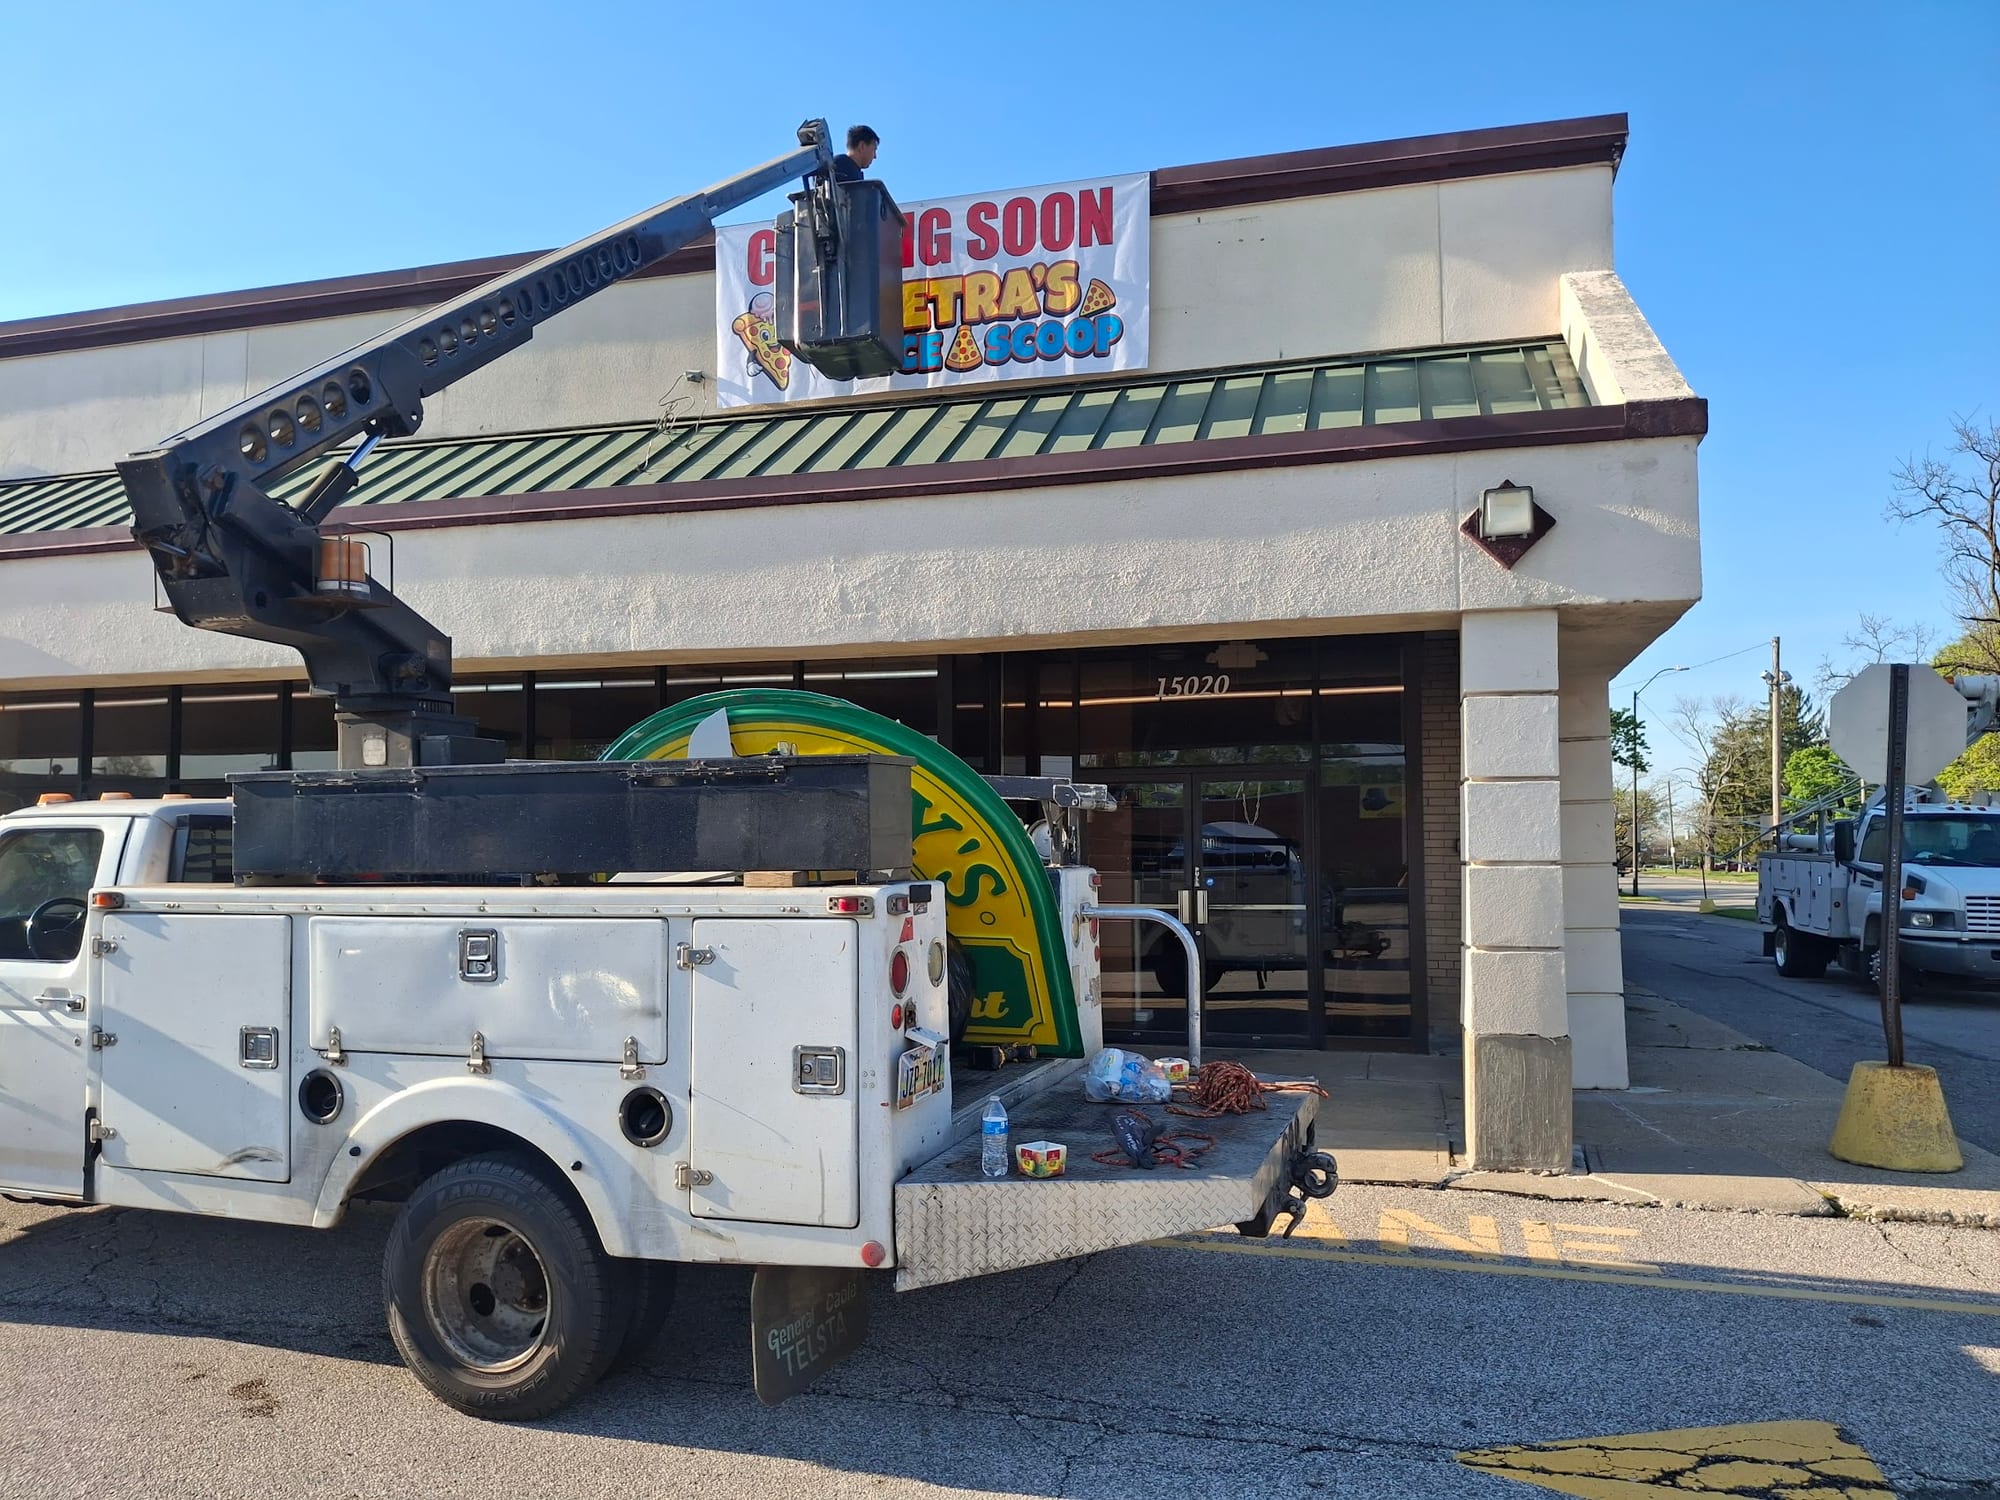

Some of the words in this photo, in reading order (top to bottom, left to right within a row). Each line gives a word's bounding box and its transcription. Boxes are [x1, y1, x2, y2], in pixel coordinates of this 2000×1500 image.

[966, 186, 1114, 261] SOON
[901, 259, 1083, 334] ETRA'S
[984, 313, 1124, 367] SCOOP
[1155, 674, 1230, 698] 15020
[1268, 1197, 1663, 1276] ANE
[767, 1307, 815, 1360] General
[781, 1311, 849, 1377] TELSTA
